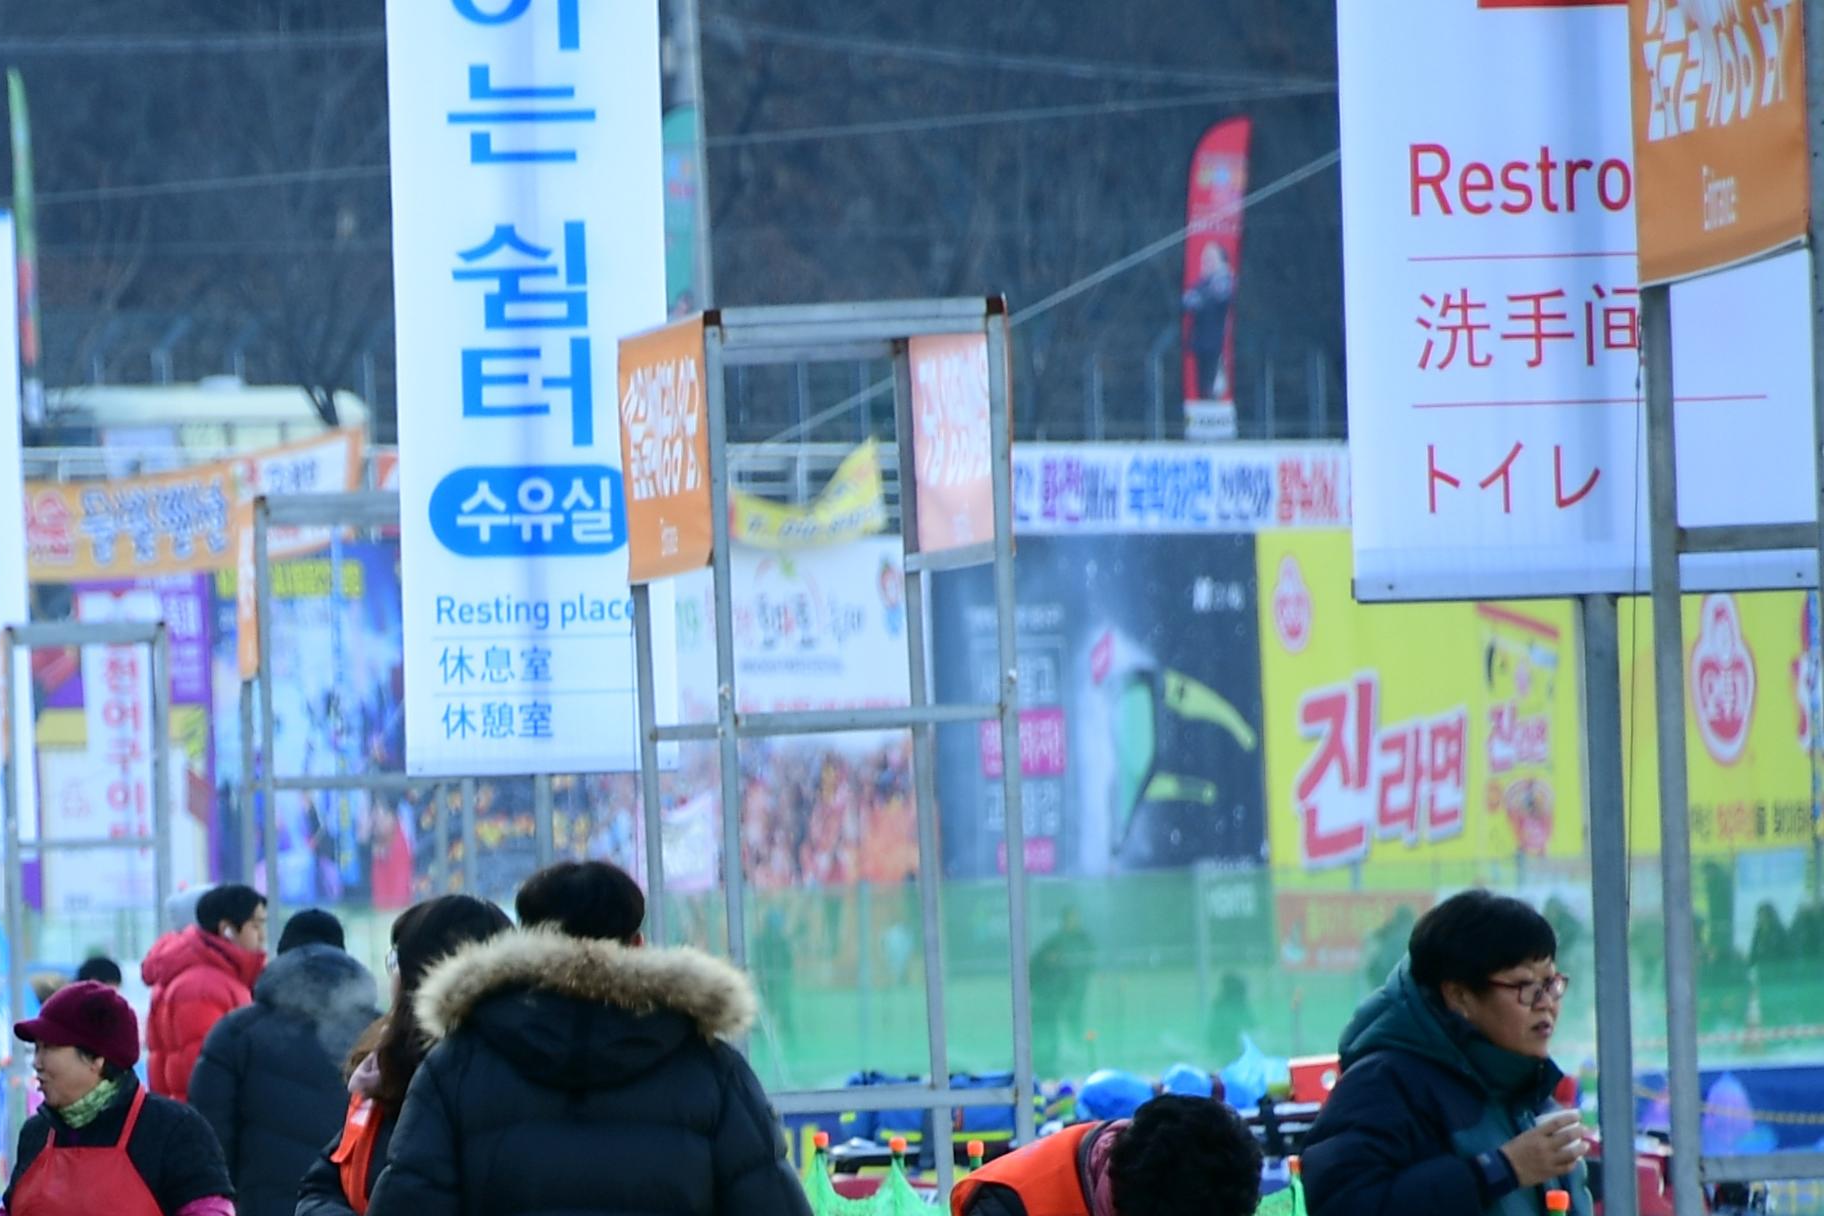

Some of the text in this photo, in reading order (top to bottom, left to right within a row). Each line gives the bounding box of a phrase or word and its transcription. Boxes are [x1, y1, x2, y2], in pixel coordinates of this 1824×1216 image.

[1409, 143, 1632, 217] Restro
[452, 220, 594, 447] 쉼터
[1416, 284, 1644, 369] 洗手间
[456, 476, 614, 544] 수유실
[1427, 441, 1601, 514] トイレ
[436, 592, 633, 630] Resting place
[438, 646, 553, 685] 休息室
[442, 701, 553, 741] 休憩室
[1295, 678, 1466, 862] 진라면
